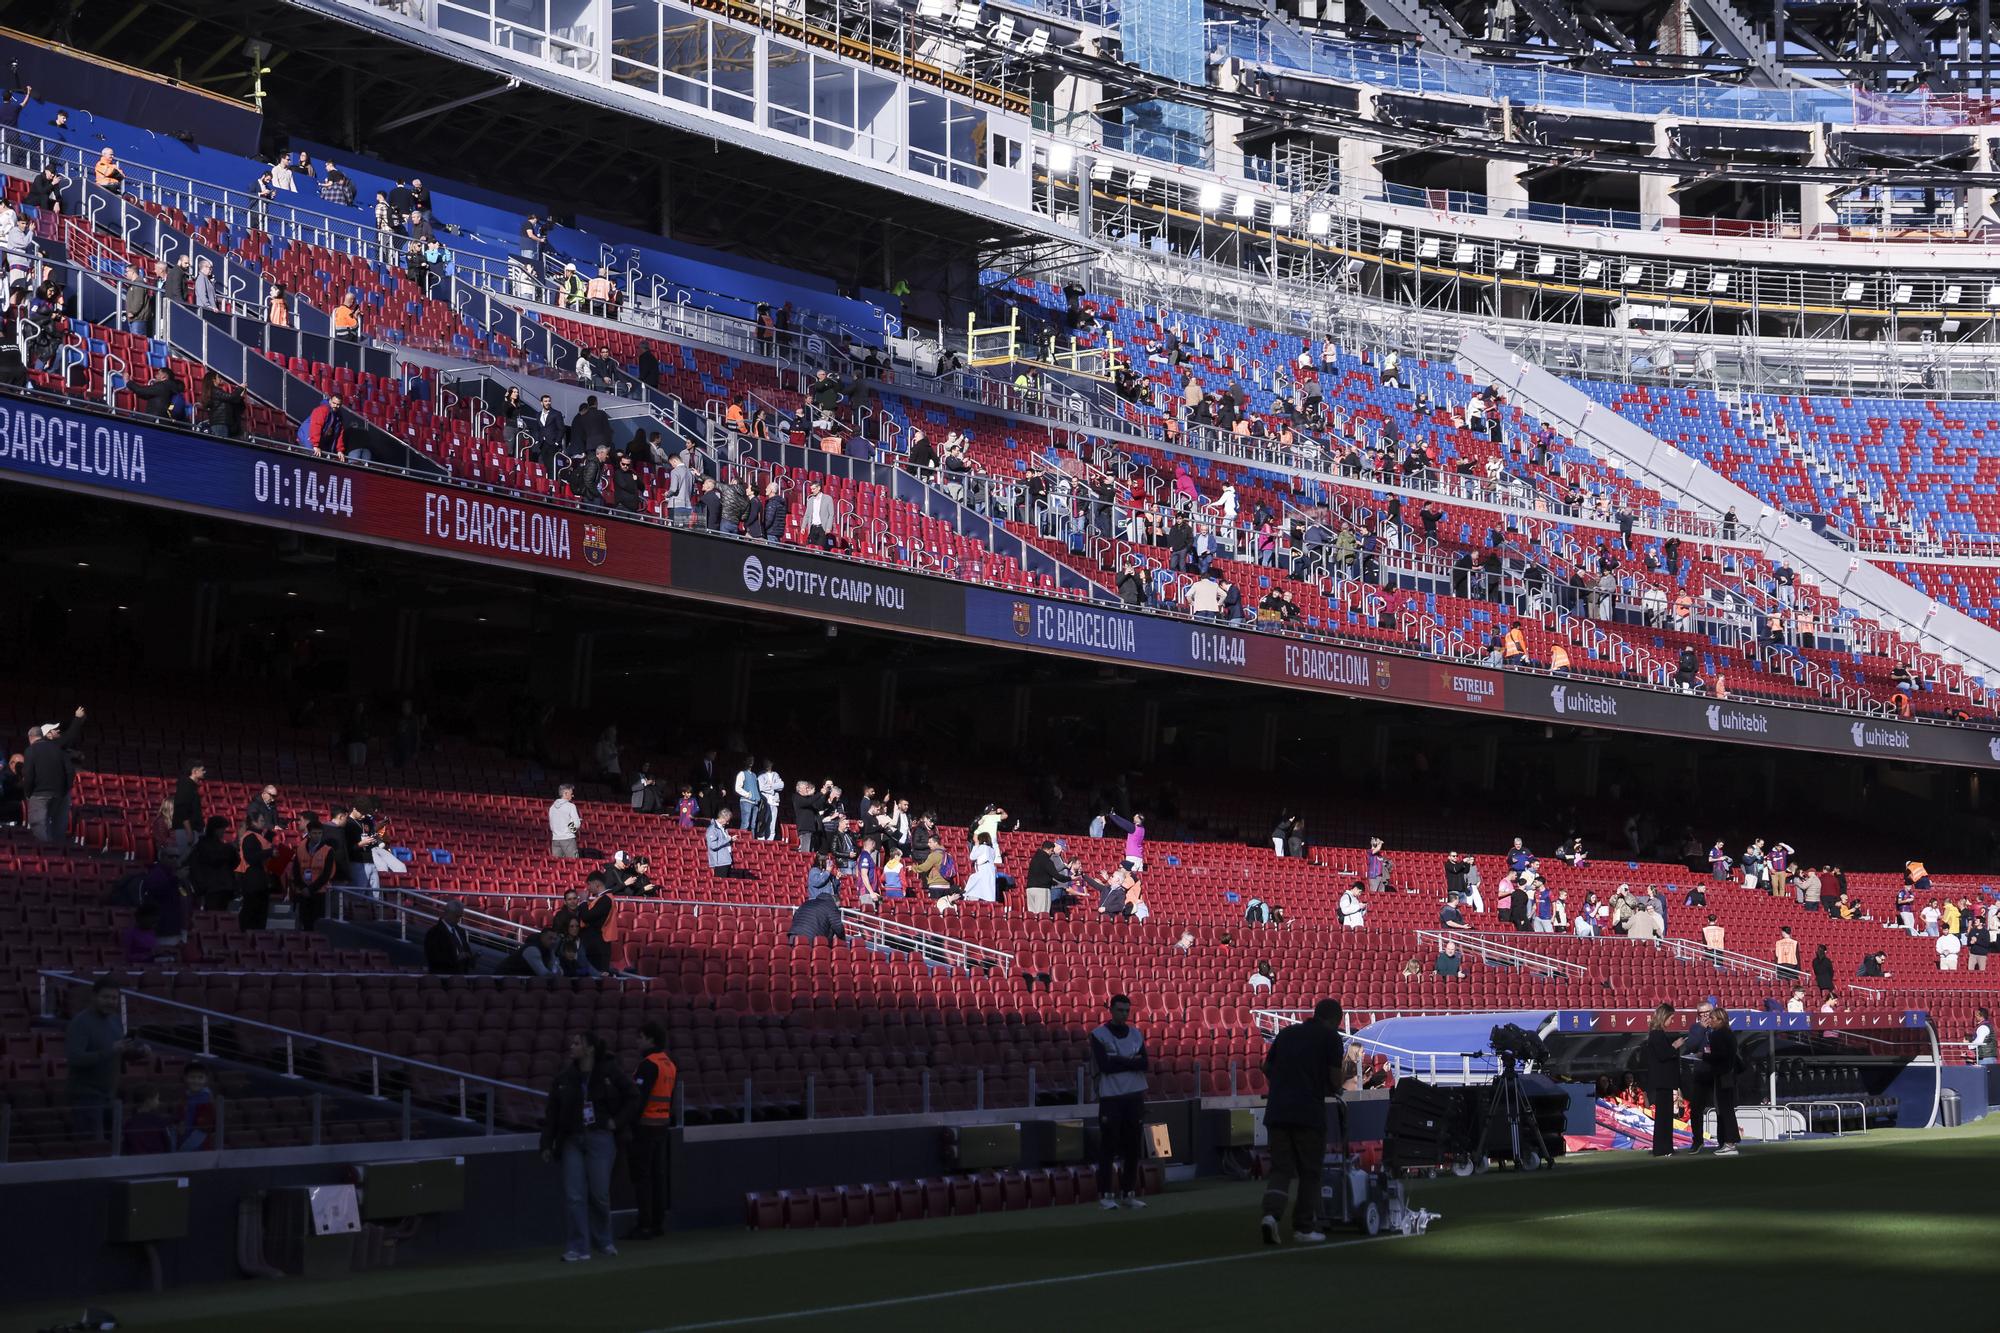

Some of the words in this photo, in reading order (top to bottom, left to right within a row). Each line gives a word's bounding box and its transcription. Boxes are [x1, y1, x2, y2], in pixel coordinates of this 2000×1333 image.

[254, 460, 353, 518] 01:14:44
[425, 492, 450, 538] FC
[455, 498, 571, 560] BARCELONA
[766, 565, 828, 597] SPOTIFY
[831, 577, 872, 604] CAMP
[875, 584, 905, 610] NOU
[1037, 605, 1054, 641] FC
[1057, 608, 1136, 653] BARCELONA
[1191, 631, 1246, 667] 01:14:44
[1285, 645, 1300, 677] FC
[1302, 648, 1370, 687] BARCELONA
[1453, 676, 1495, 696] ESTRELLA
[1567, 691, 1617, 715] whitebit
[1721, 712, 1768, 733] whitebit
[1865, 730, 1910, 749] whitebit
